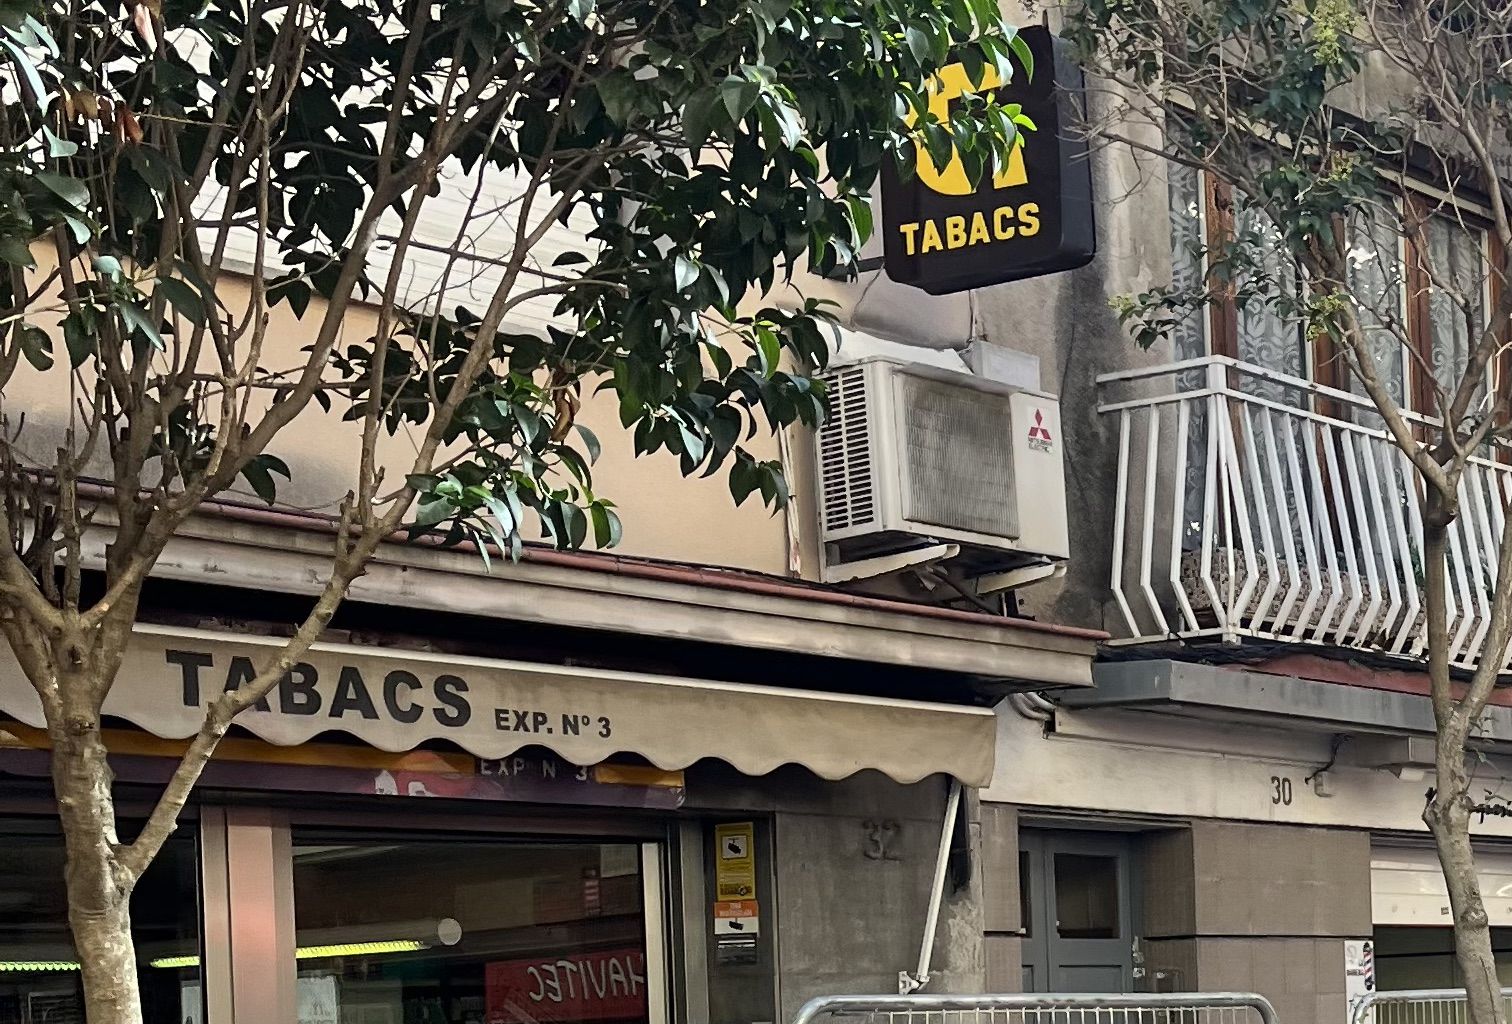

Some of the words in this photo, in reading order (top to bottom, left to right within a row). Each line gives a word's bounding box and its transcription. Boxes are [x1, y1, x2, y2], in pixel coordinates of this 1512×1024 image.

[899, 202, 1041, 256] TABACS
[165, 648, 472, 728] TABACS
[494, 708, 553, 734] EXP.
[562, 713, 590, 736] Nº
[597, 716, 612, 739] 3
[1271, 776, 1292, 806] 30
